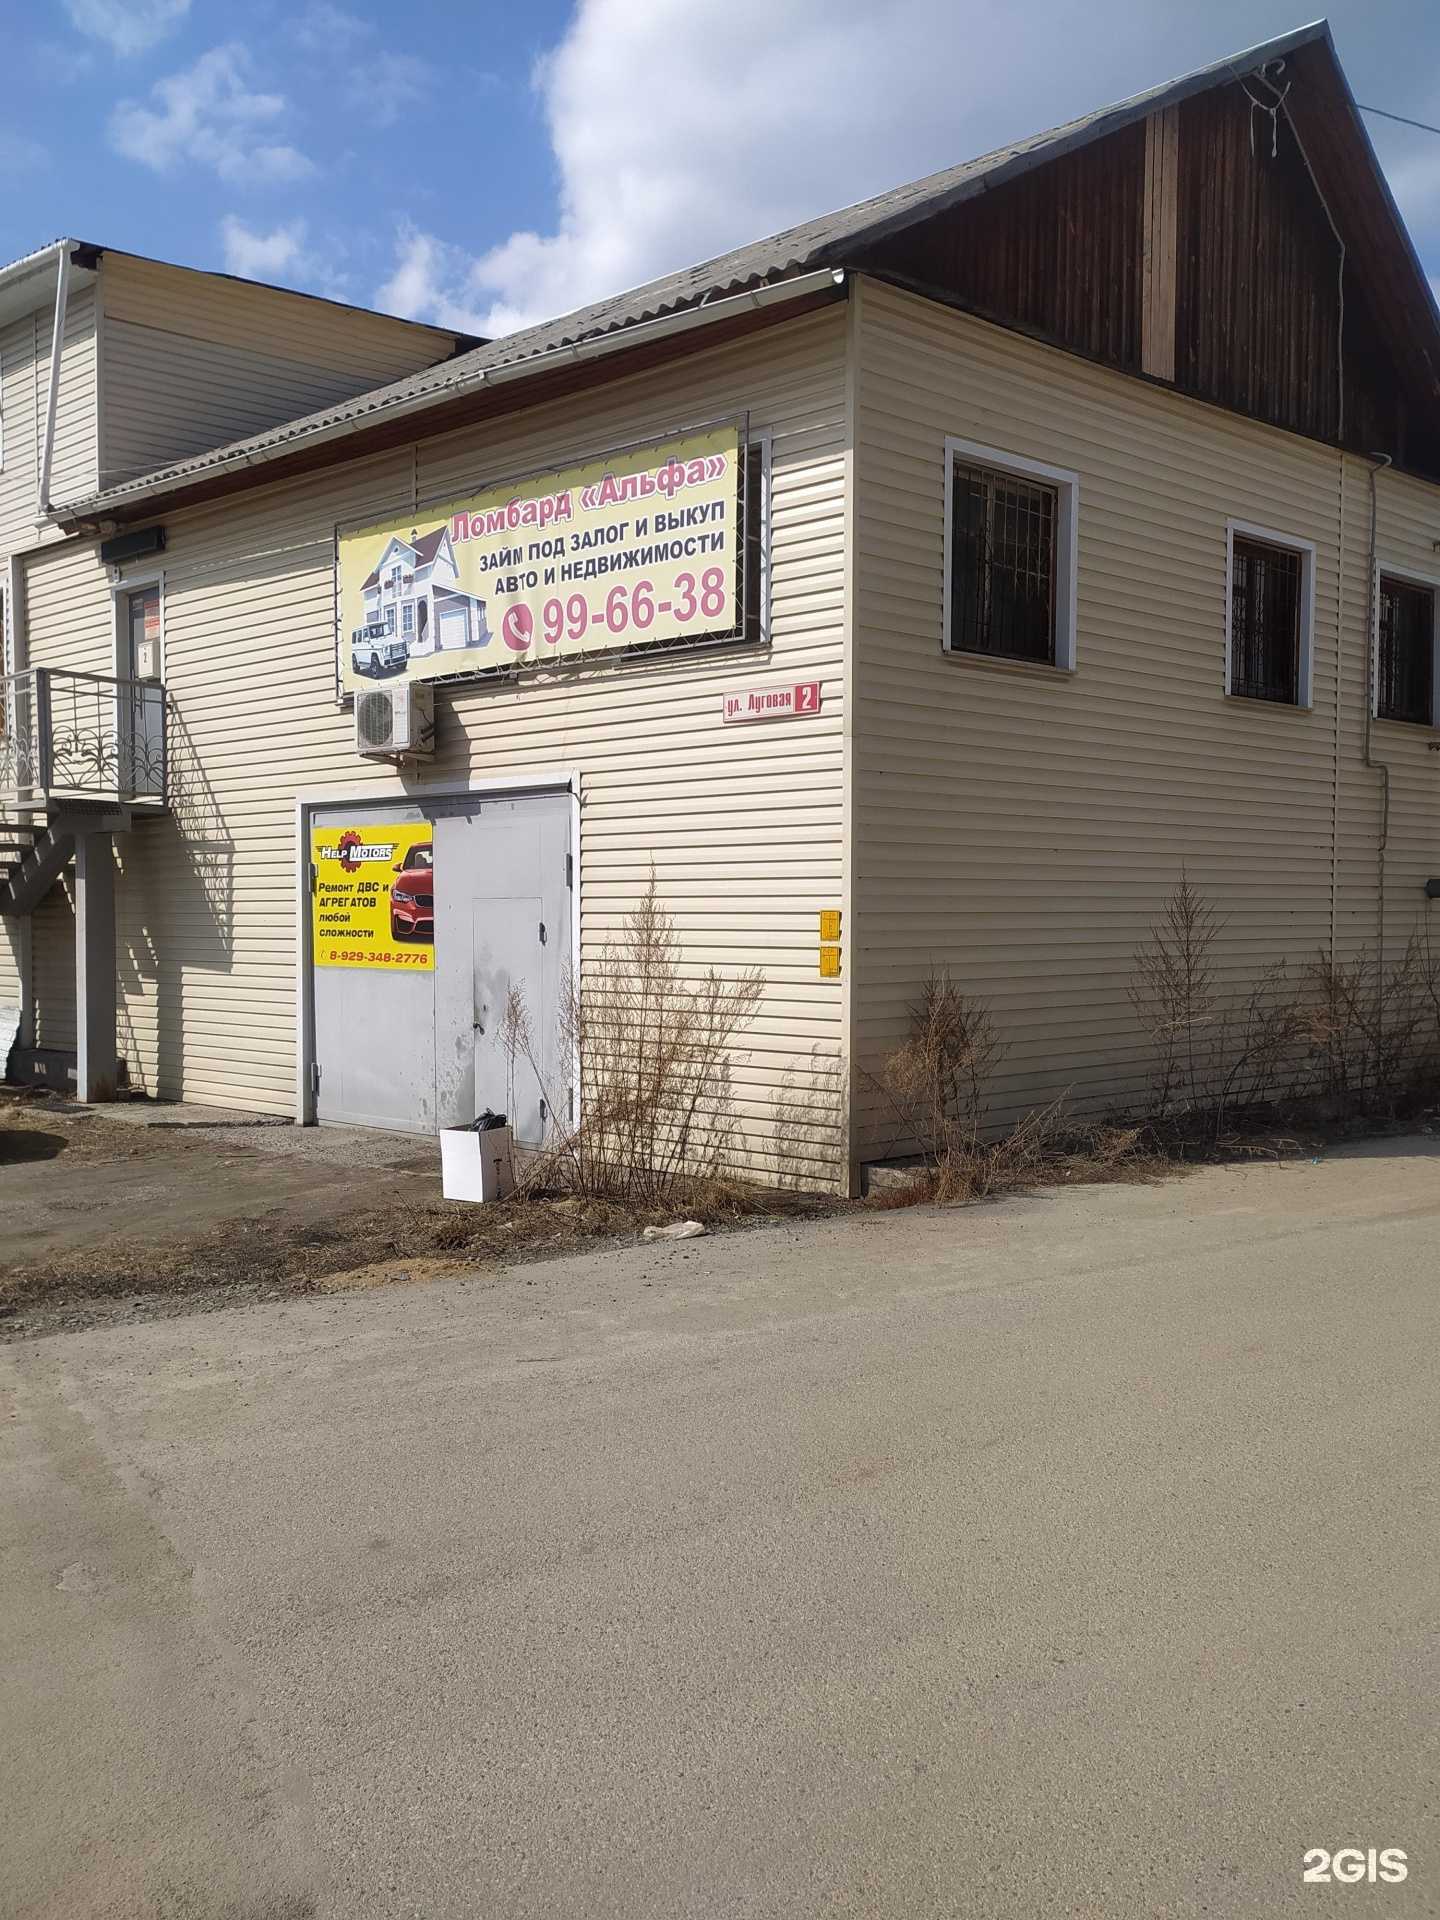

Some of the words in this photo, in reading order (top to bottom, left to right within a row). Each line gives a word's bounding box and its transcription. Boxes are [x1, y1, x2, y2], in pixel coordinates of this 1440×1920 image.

[451, 491, 573, 543] Ломбард
[581, 454, 727, 510] «Альфа»
[479, 546, 524, 572] ЗАЙМ
[528, 539, 566, 562] ПОД
[570, 522, 629, 551] ЗАЛОГ
[635, 518, 648, 538] И
[654, 500, 725, 532] ВЫКУП
[495, 571, 538, 596] АВТО
[544, 567, 555, 586] И
[560, 531, 725, 582] НЕДВИЖИМОСТИ
[543, 567, 726, 645] 99-66-38
[727, 698, 742, 716] ул.
[748, 692, 792, 712] Луговая
[802, 686, 812, 709] 2
[318, 883, 354, 893] Ремонт
[357, 882, 379, 893] ДВС
[383, 884, 389, 892] и
[319, 897, 377, 908] АГРЕГАТОВ
[319, 912, 351, 923] любой
[319, 929, 374, 938] сложности
[329, 951, 428, 964] 8-929-348-2776
